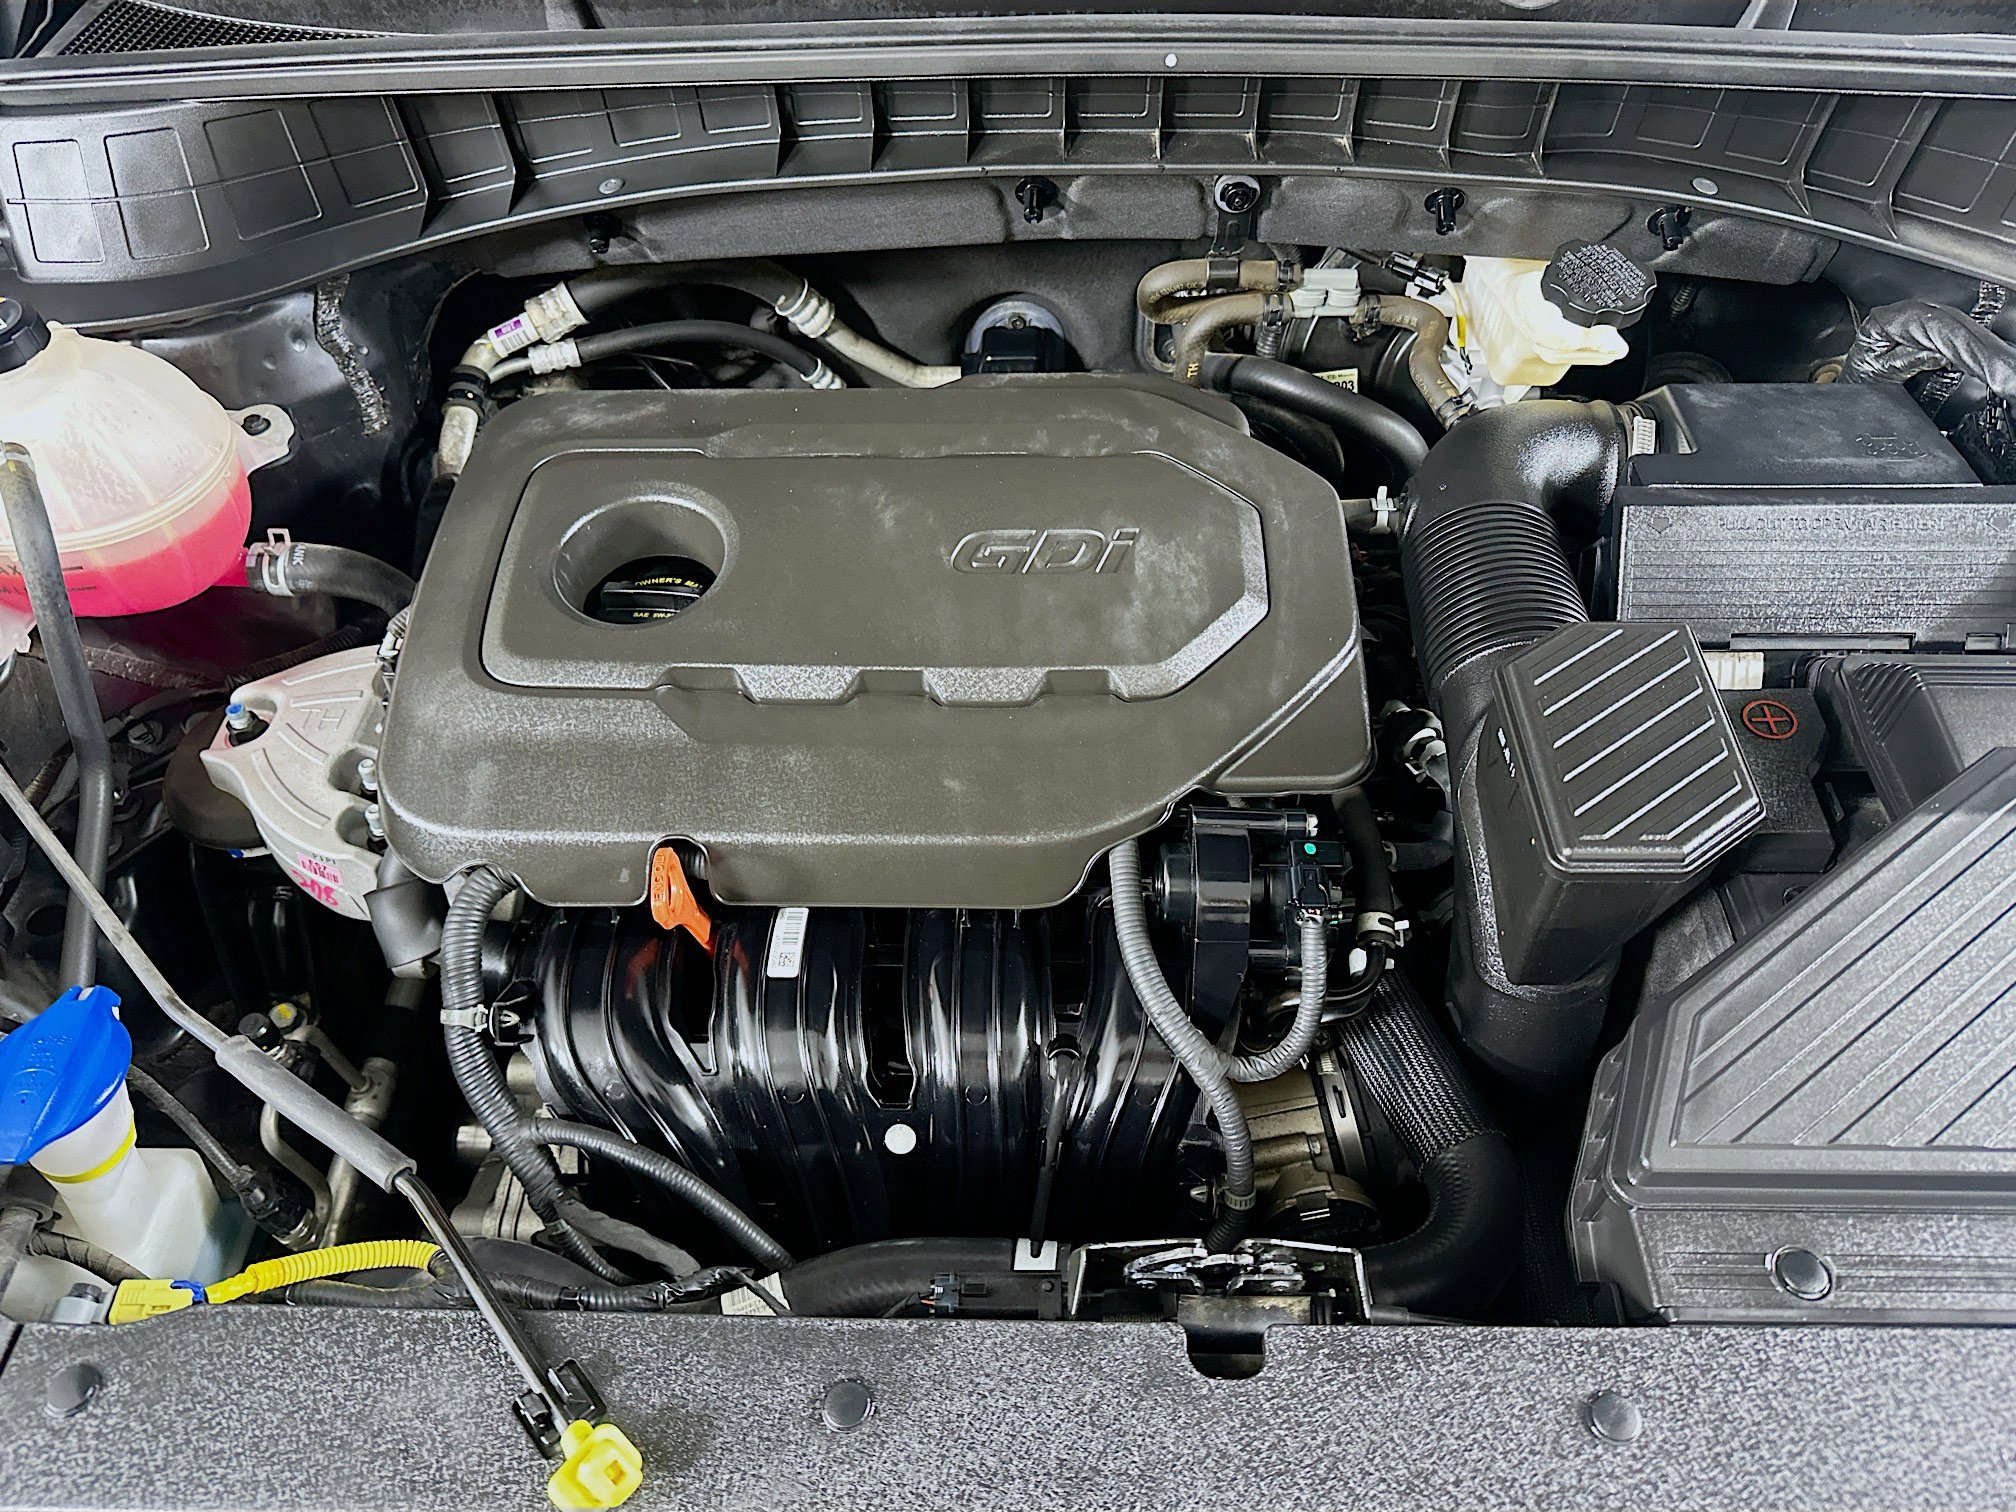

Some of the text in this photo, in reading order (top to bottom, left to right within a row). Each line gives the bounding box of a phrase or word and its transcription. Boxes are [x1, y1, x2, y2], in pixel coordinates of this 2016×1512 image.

[292, 543, 307, 566] ANK
[950, 527, 1140, 574] GDi
[634, 577, 683, 586] OWNER'S
